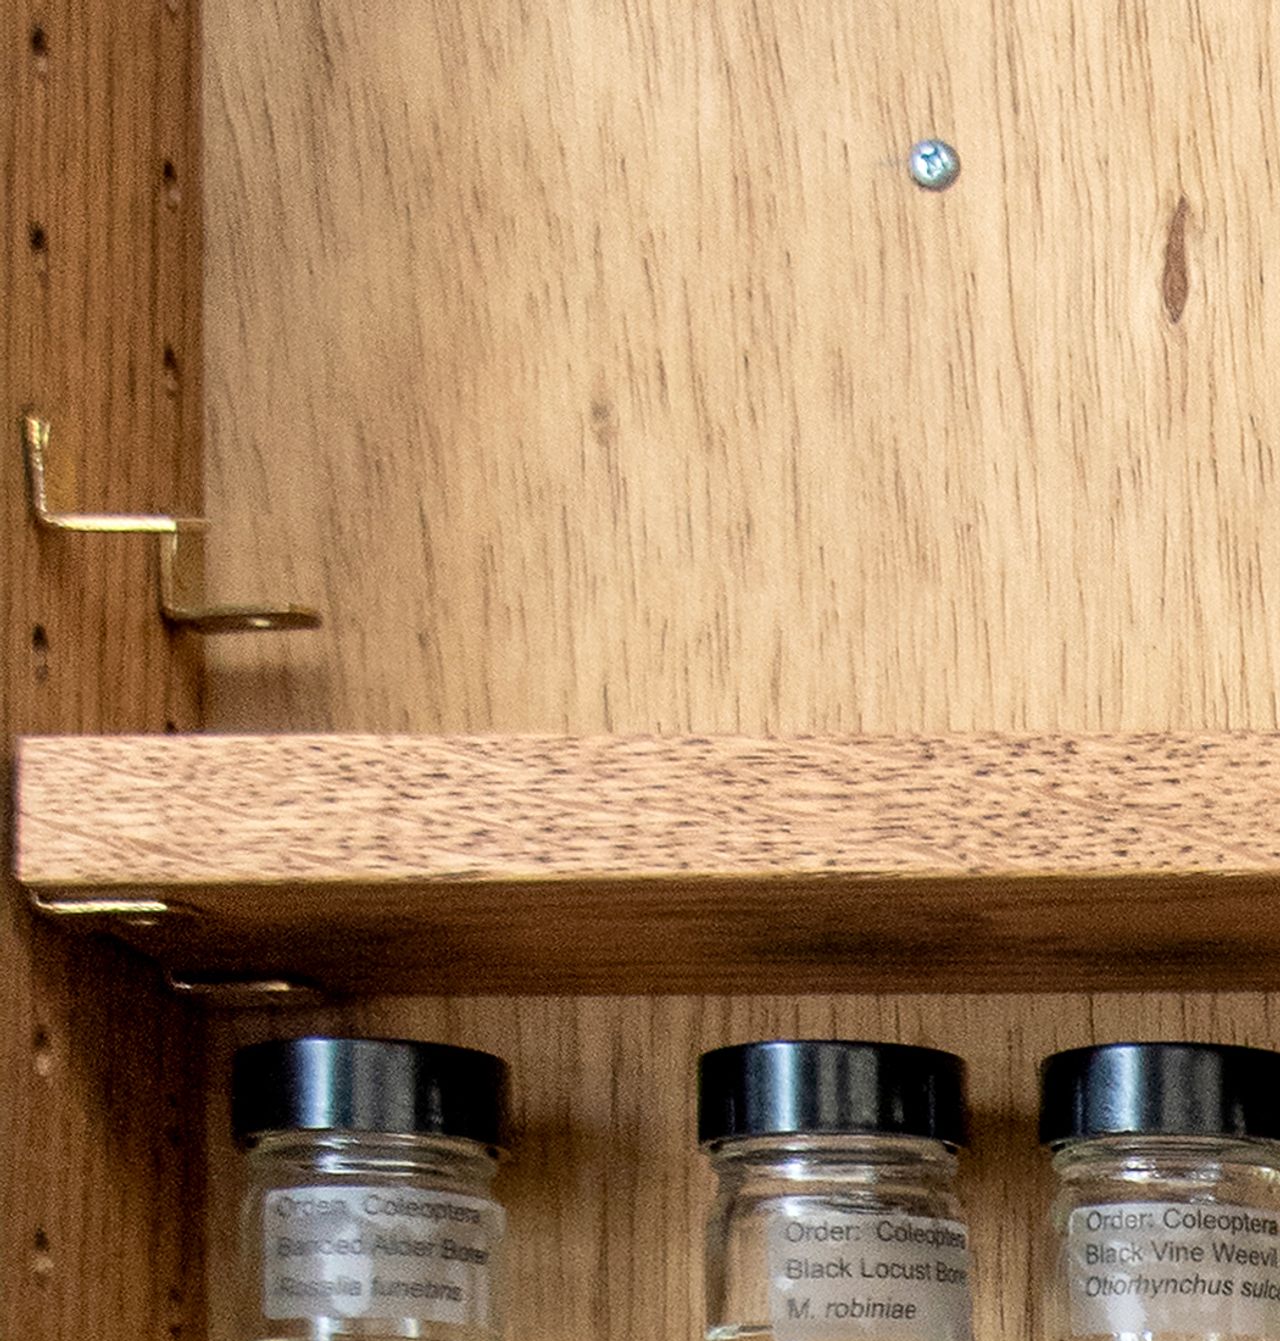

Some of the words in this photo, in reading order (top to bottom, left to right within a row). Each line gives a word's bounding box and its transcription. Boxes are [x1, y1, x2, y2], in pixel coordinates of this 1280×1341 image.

[785, 1221, 860, 1243] Order:
[1086, 1210, 1153, 1233] Order:
[1163, 1208, 1279, 1237] Coleoptera
[1086, 1243, 1143, 1266] Black
[1151, 1240, 1205, 1263] Vine
[1212, 1242, 1279, 1269] Weevil
[785, 1257, 853, 1280] Black
[860, 1258, 931, 1282] Locust
[1086, 1273, 1234, 1302] Otiorhynchus
[787, 1298, 815, 1320] M.
[826, 1298, 918, 1320] robiniae
